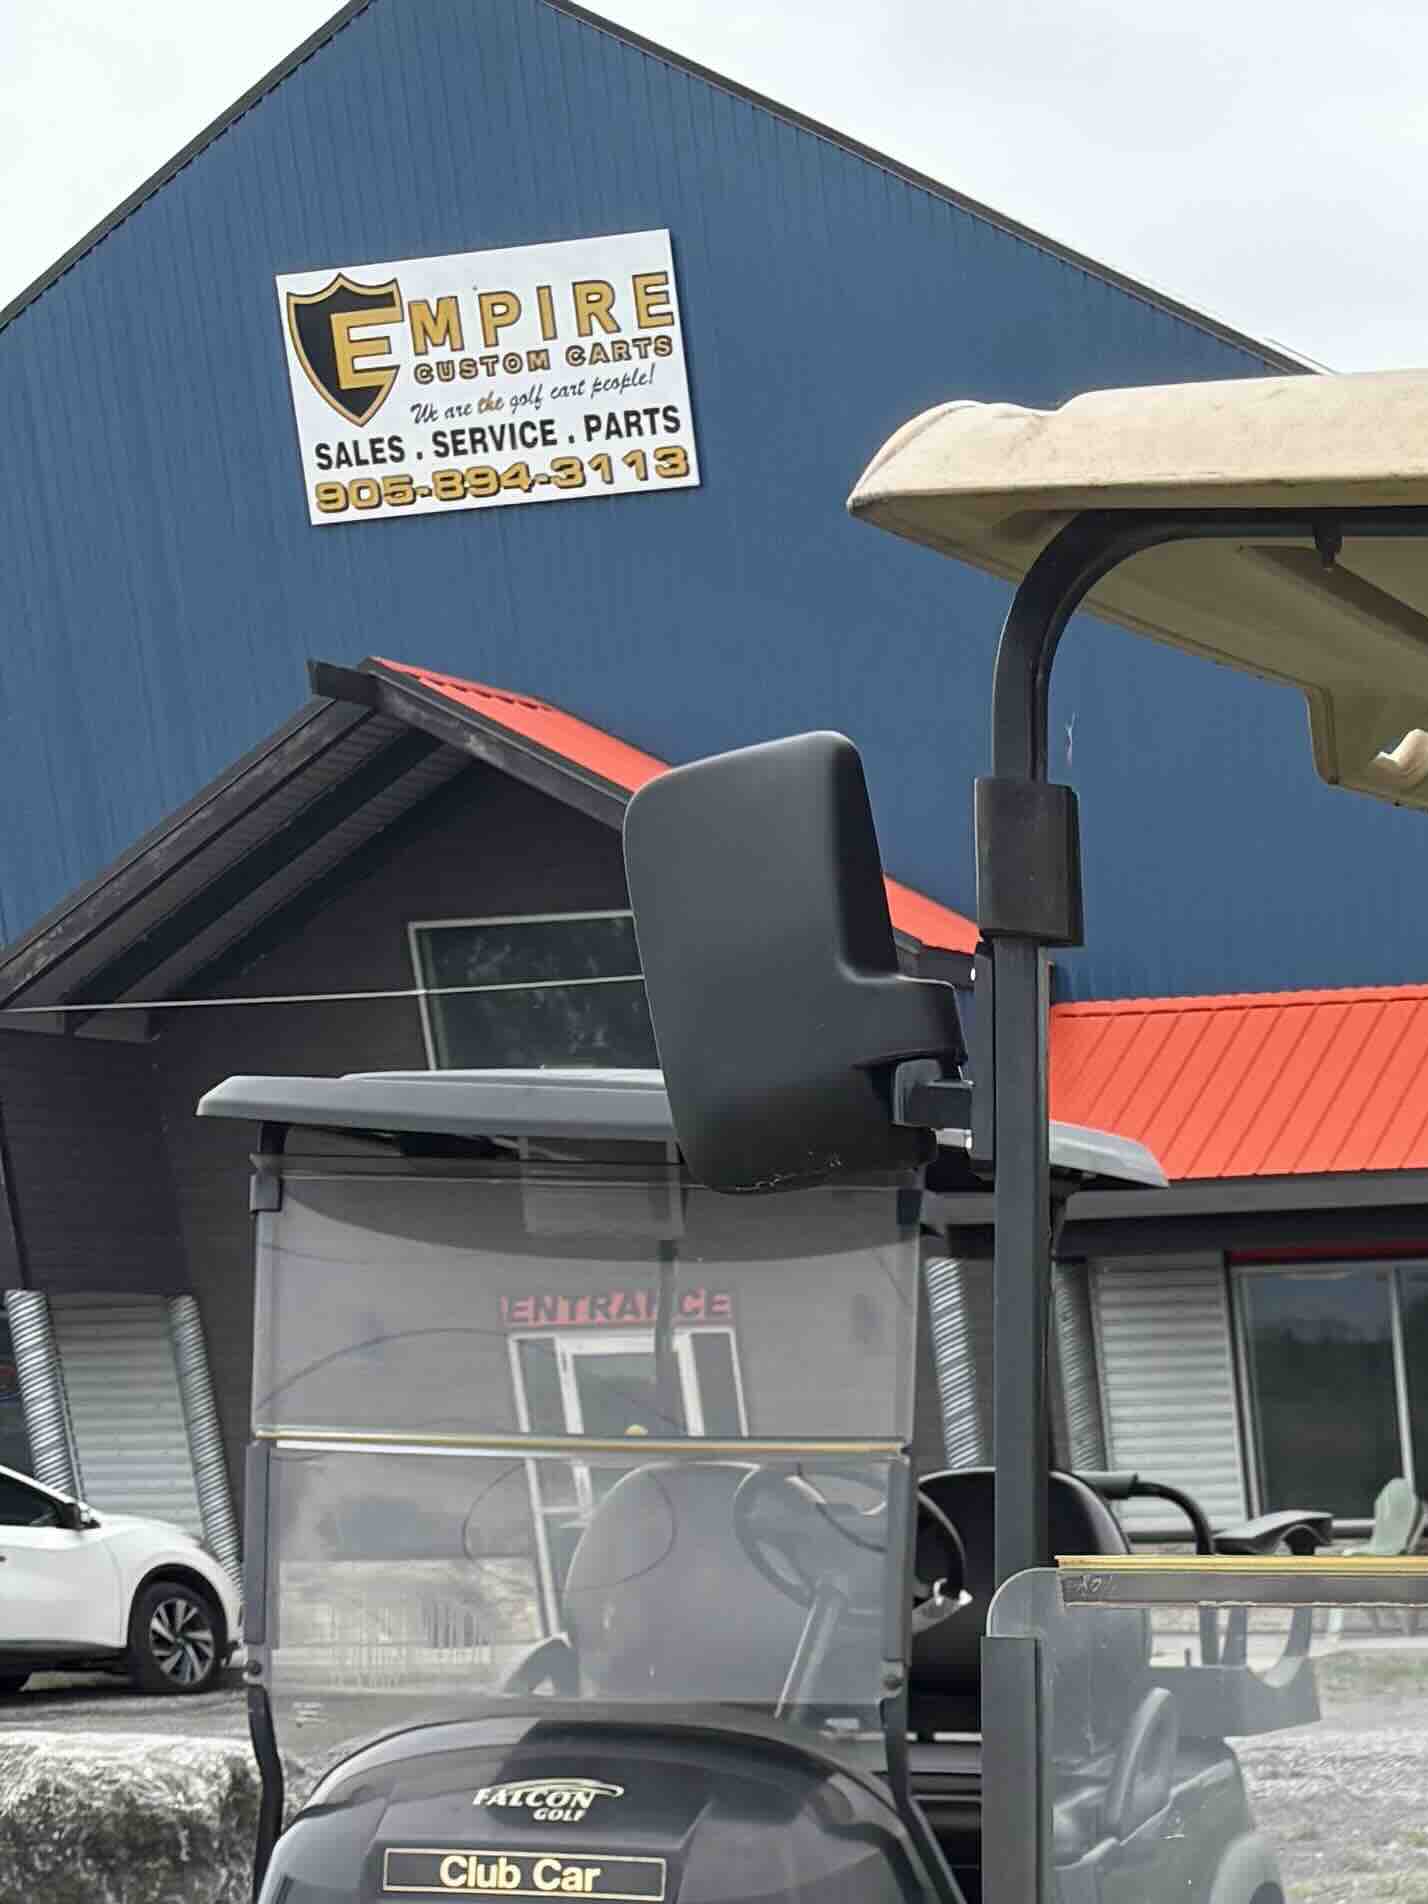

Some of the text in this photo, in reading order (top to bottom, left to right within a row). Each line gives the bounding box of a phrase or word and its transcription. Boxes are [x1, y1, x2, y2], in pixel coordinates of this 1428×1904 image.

[330, 271, 675, 391] EMPIRE
[413, 335, 674, 385] CUSTOM CARTS
[411, 362, 656, 425] We are the golf cart people!
[314, 434, 403, 471] SALES
[431, 418, 558, 459] SERVICE
[584, 405, 682, 443] PARTS
[314, 446, 691, 514] 905-894-3113
[472, 1787, 597, 1809] FALCON
[533, 1808, 587, 1823] GOLF
[439, 1855, 602, 1893] Club Car
